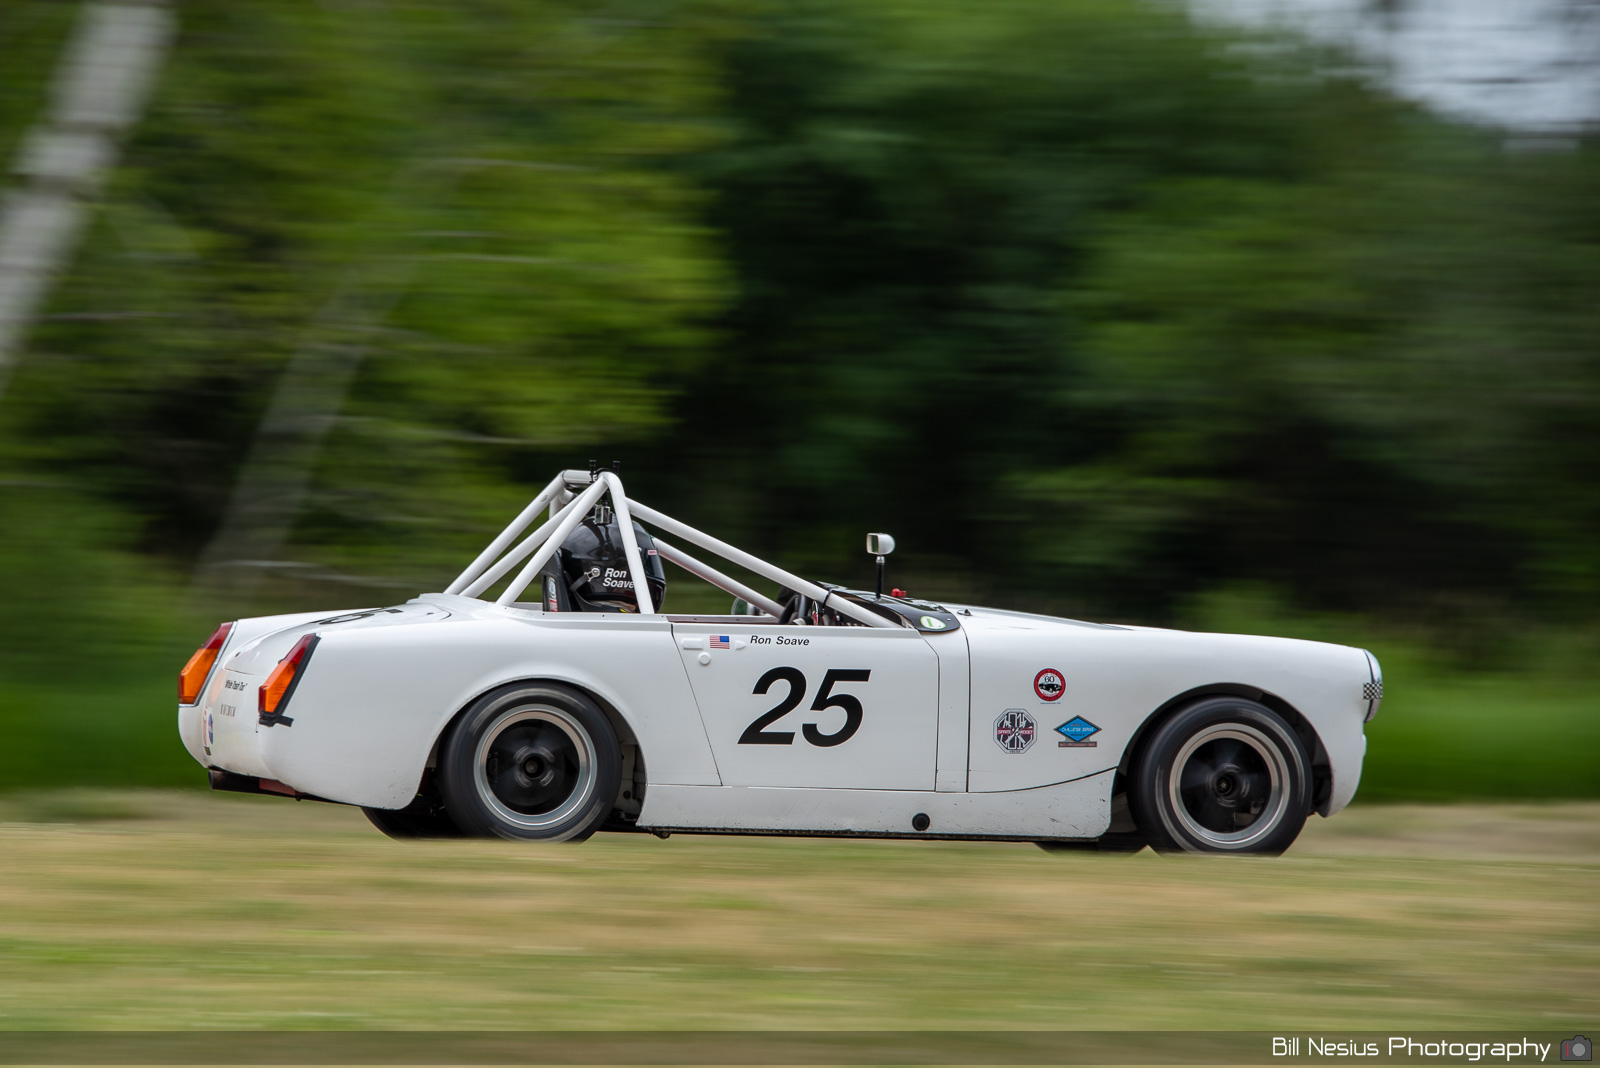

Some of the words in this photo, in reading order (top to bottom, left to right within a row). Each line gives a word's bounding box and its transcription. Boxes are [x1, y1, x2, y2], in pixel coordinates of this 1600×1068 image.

[604, 567, 627, 578] Ron
[602, 577, 635, 589] Soave
[749, 635, 772, 645] Ron
[776, 635, 810, 646] Soave
[1044, 675, 1055, 683] 60
[737, 666, 872, 748] 25
